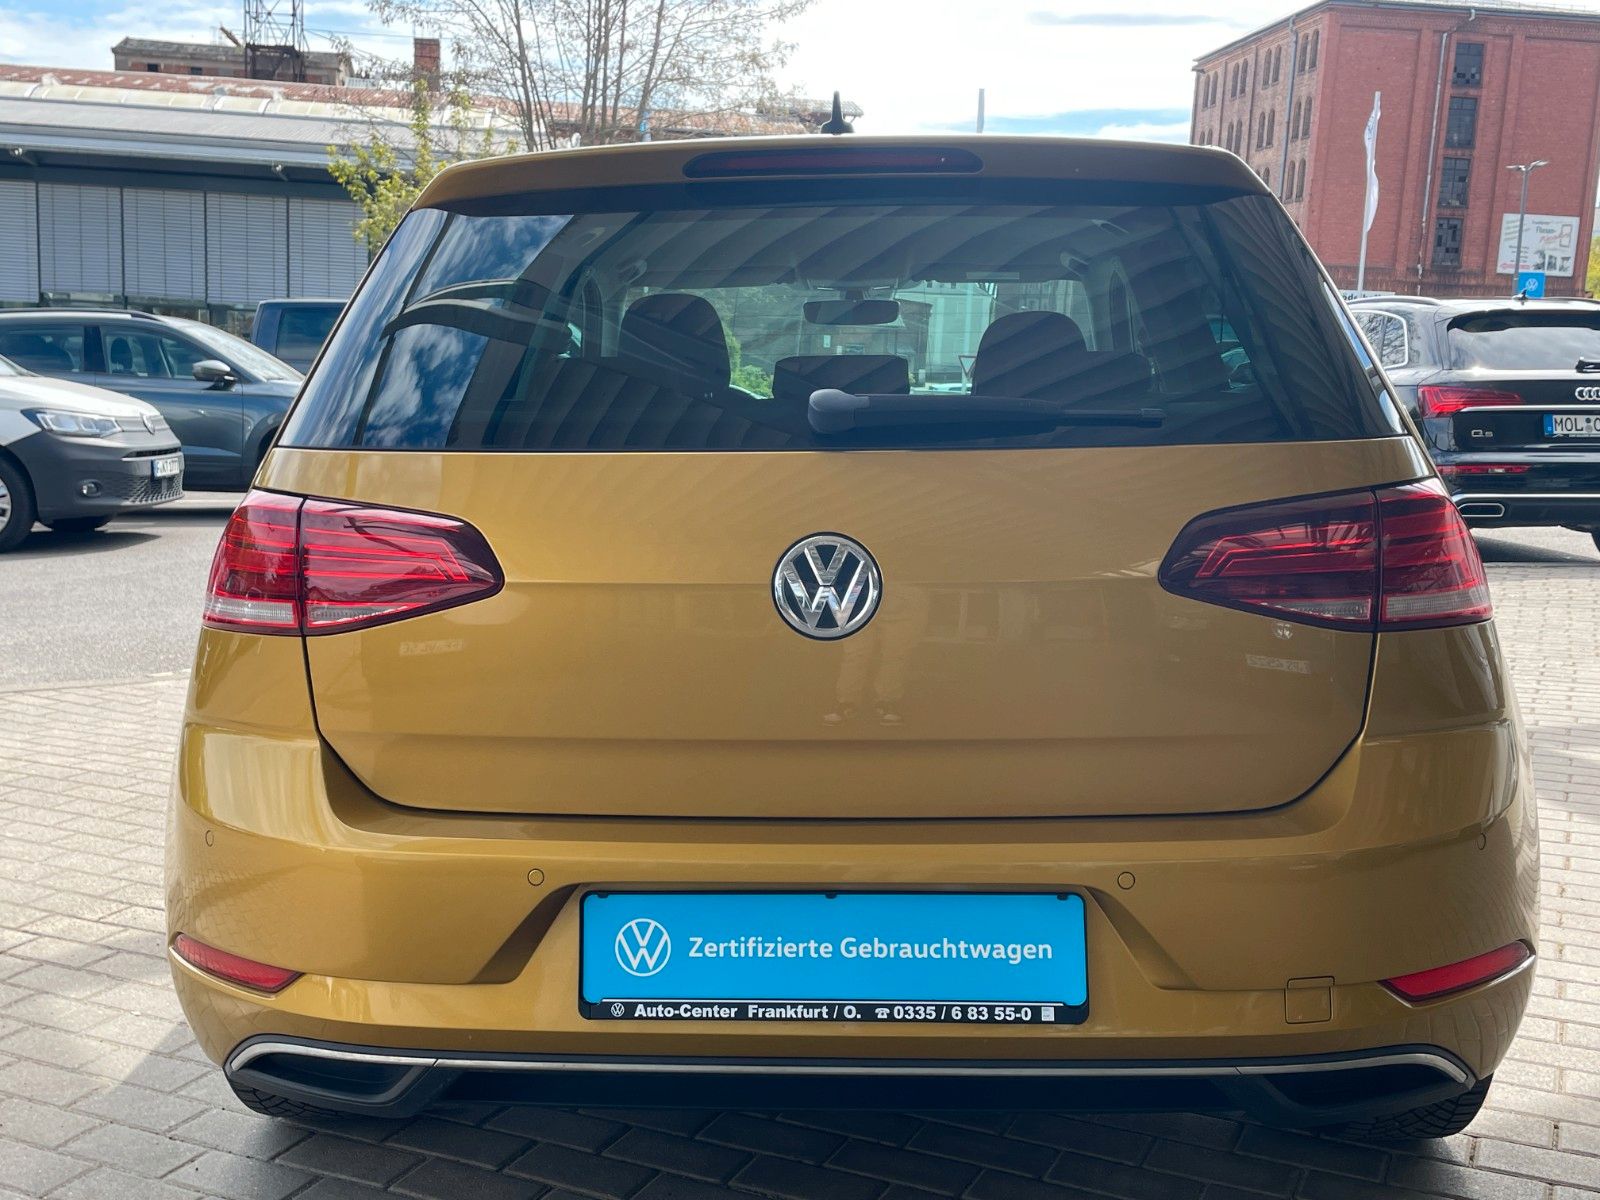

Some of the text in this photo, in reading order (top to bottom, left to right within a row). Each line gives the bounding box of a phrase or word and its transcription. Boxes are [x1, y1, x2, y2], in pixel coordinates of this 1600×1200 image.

[1554, 417, 1584, 432] MOL
[688, 936, 1053, 964] Zertifizierte Gebrauchtwagen
[634, 1003, 738, 1018] Auto-Center
[748, 1004, 829, 1019] Frankfurt
[893, 1005, 937, 1020] 0335
[994, 1007, 1032, 1021] 55-0
